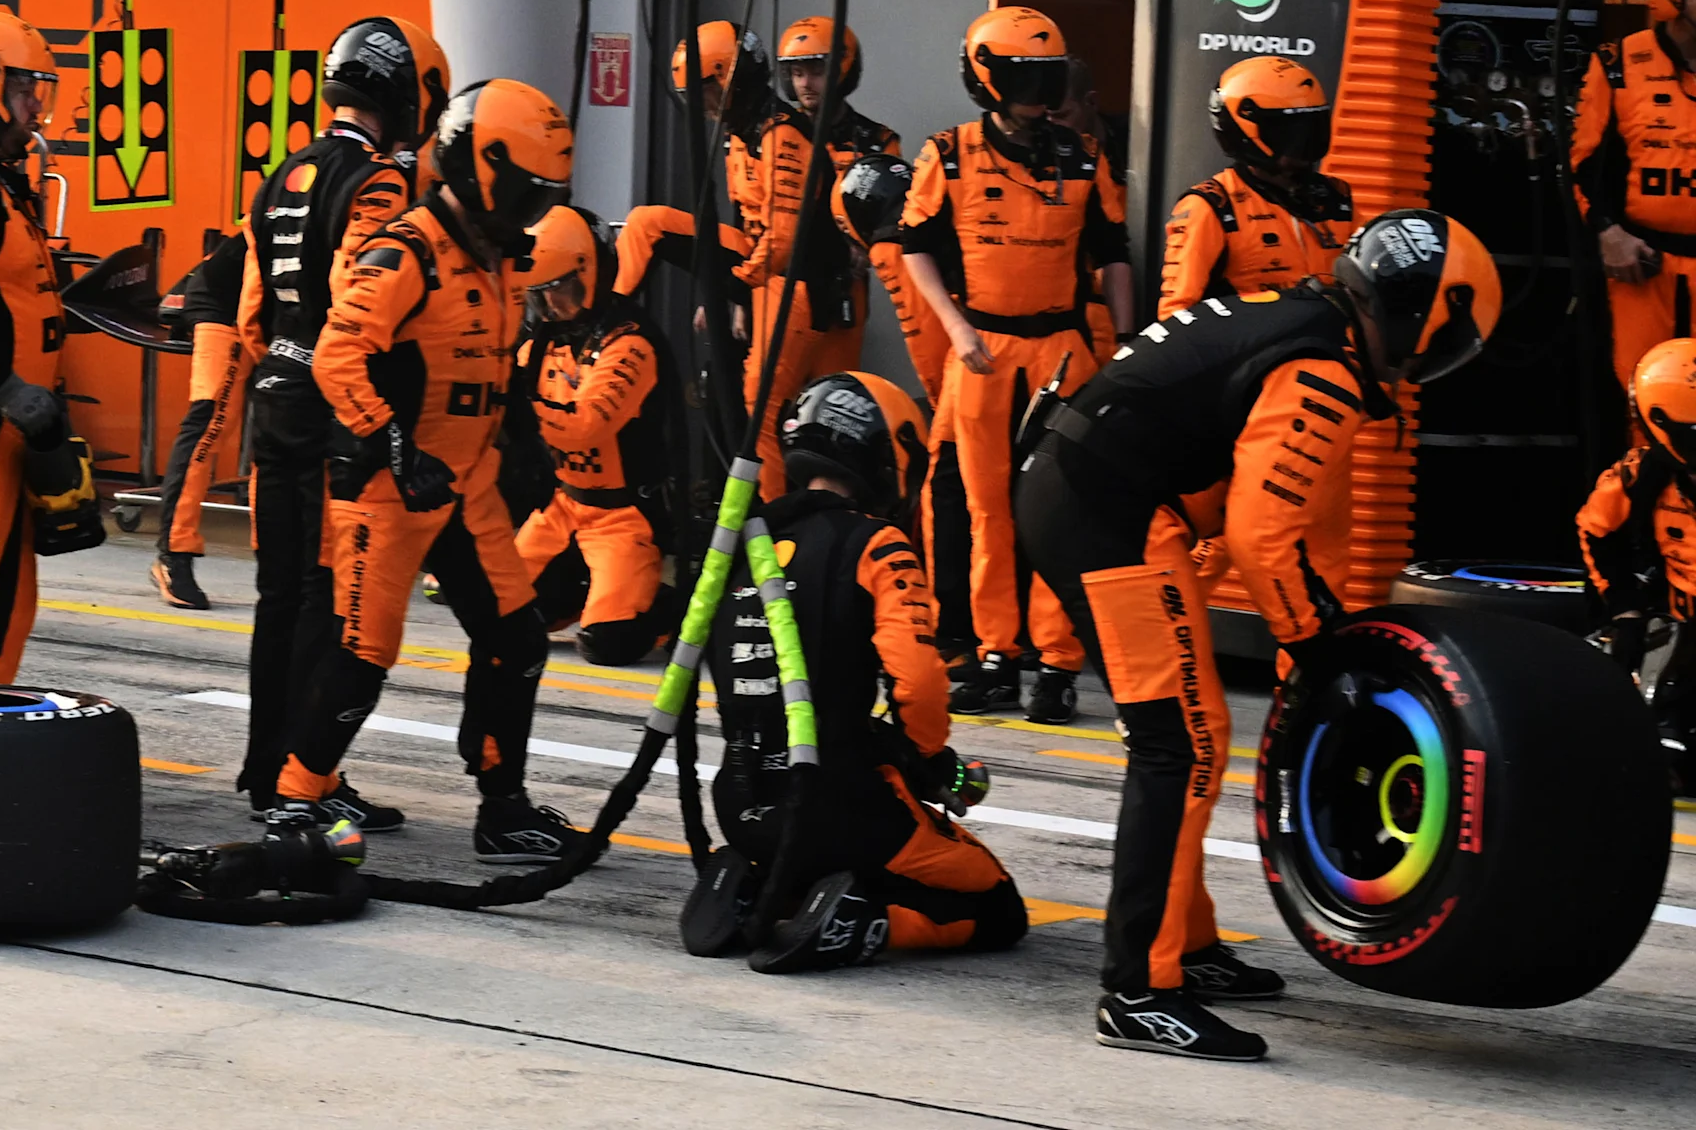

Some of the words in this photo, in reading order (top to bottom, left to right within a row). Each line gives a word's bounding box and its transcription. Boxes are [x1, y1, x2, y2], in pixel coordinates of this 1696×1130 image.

[1198, 33, 1228, 50] DP
[1229, 34, 1316, 56] WORLD
[194, 414, 227, 463] NUTRITION
[349, 560, 366, 631] OPTIMUM
[1174, 625, 1202, 708] OPTIMUM
